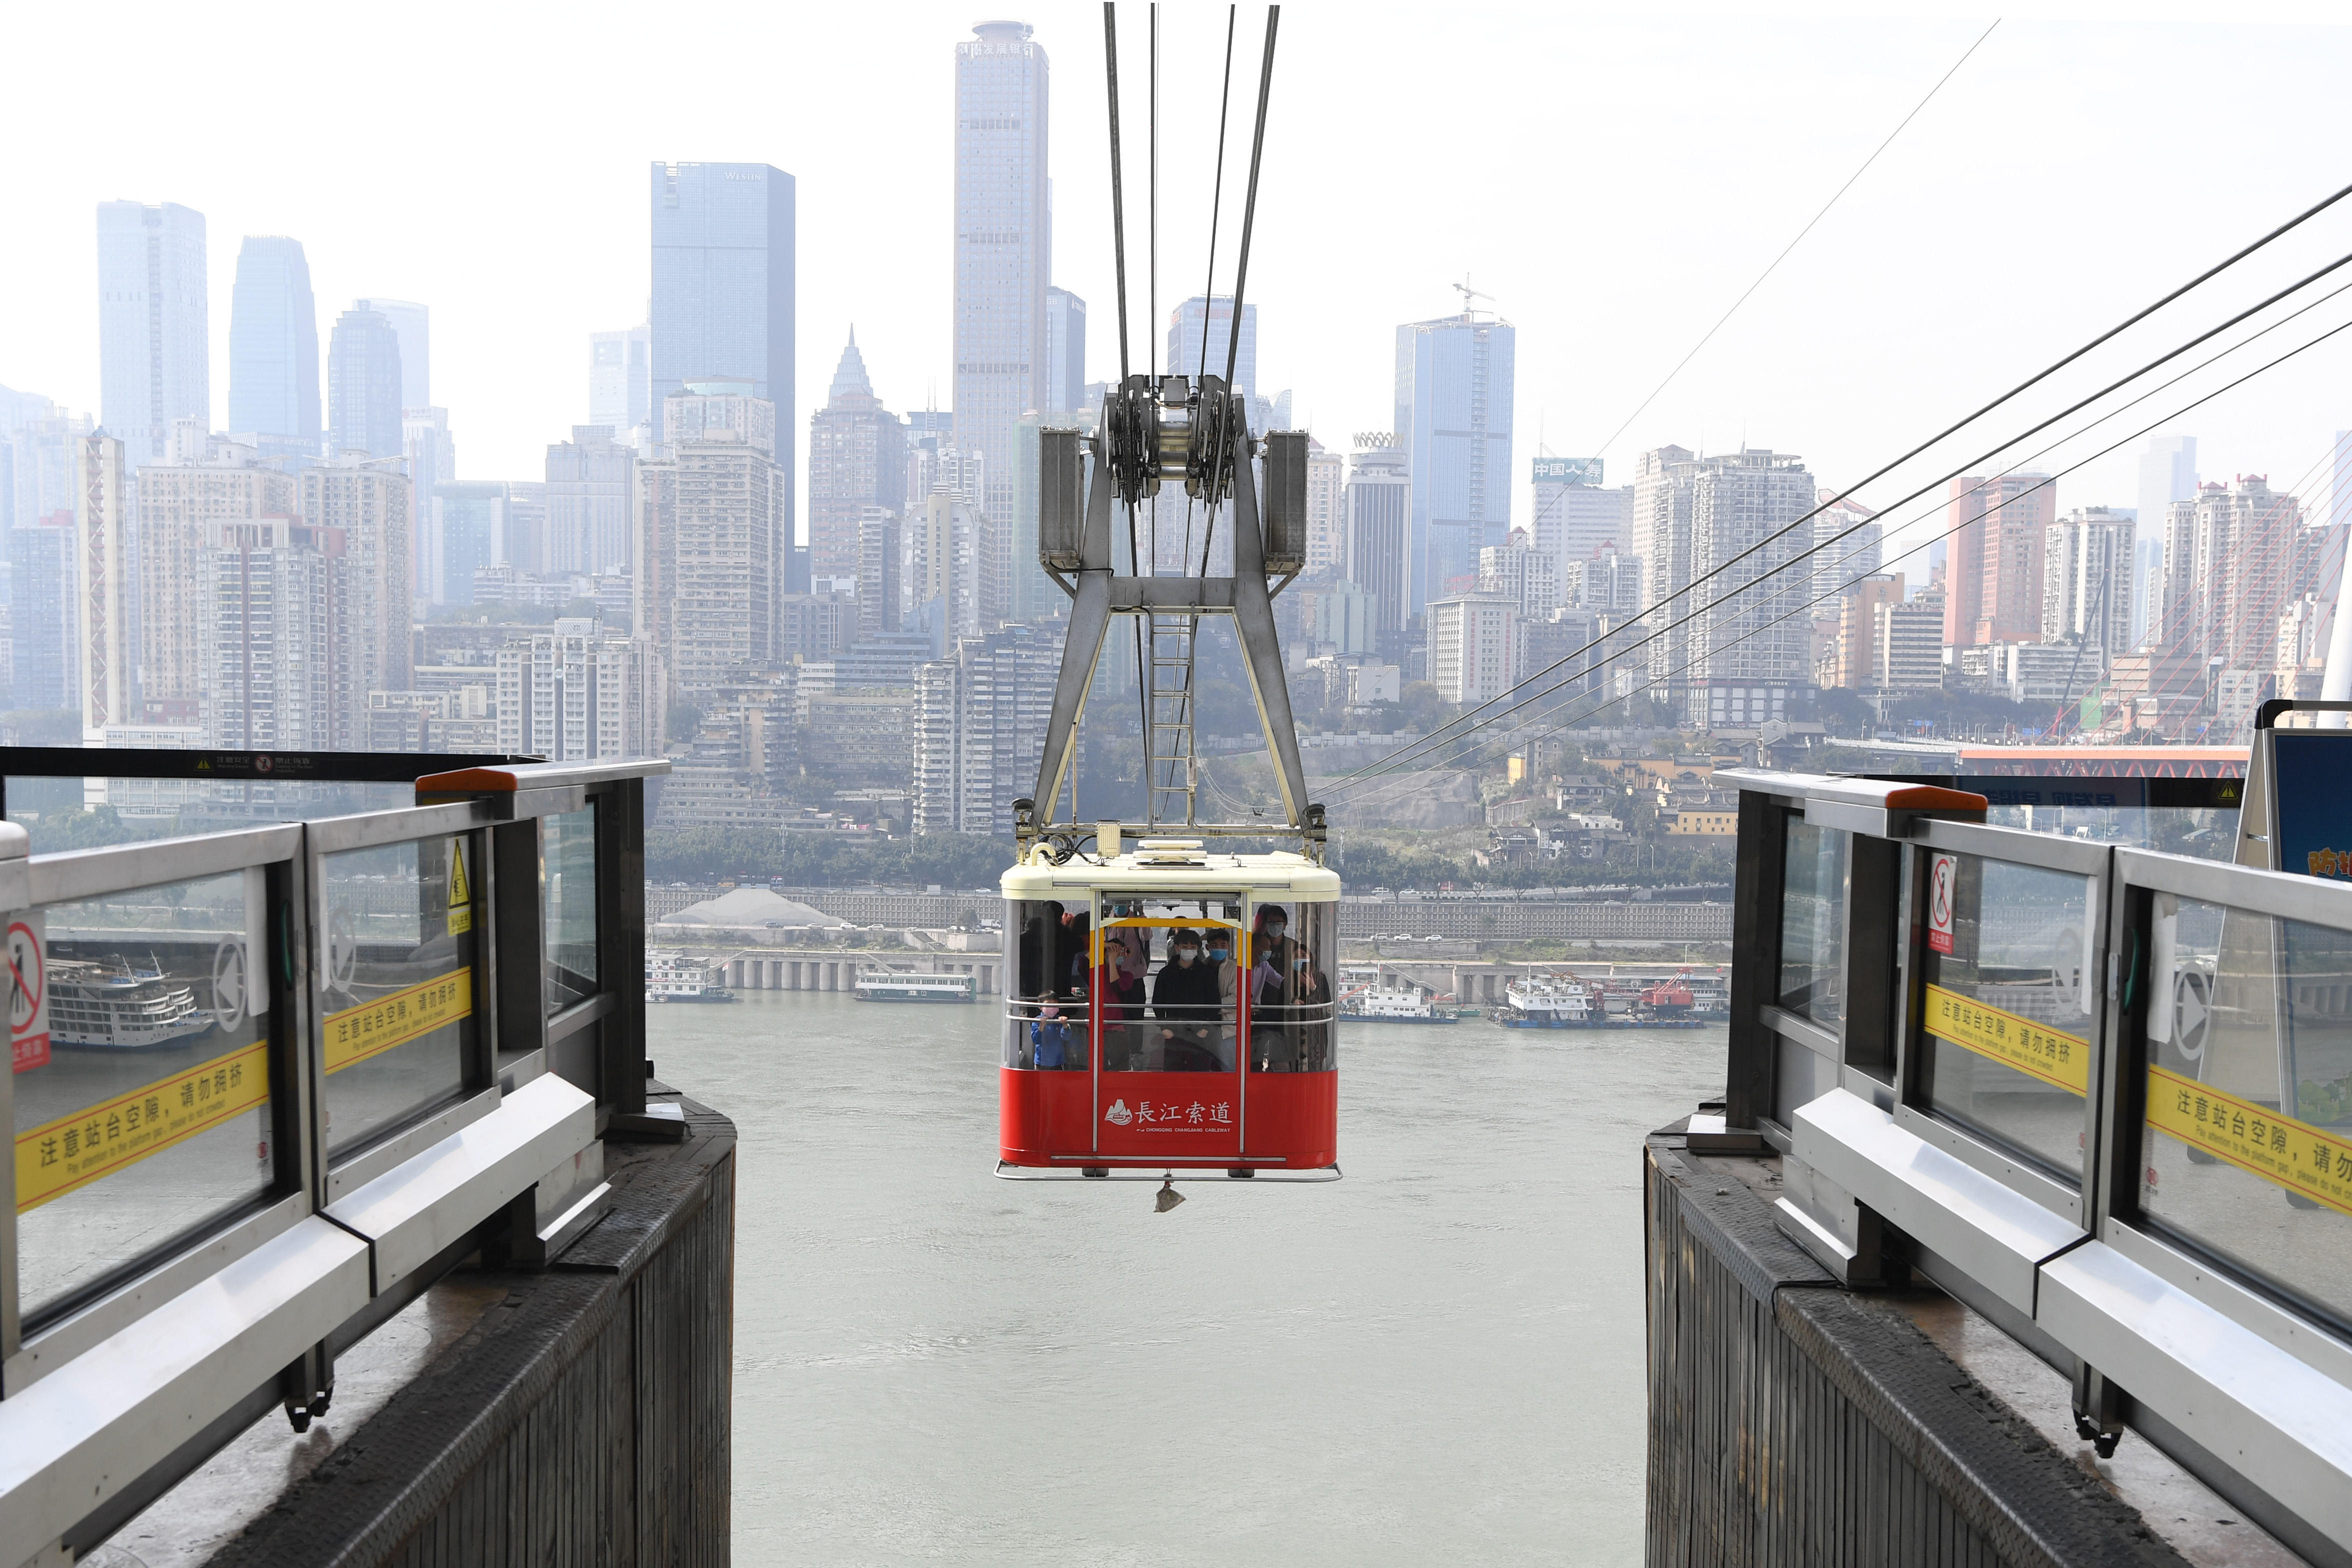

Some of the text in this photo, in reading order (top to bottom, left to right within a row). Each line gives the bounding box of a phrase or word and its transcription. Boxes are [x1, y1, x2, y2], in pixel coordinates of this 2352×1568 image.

[724, 172, 760, 180] WESTIN
[1534, 461, 1602, 477] 中国人寿
[338, 982, 456, 1043] 注意站台空隙，请勿拥挤
[1942, 999, 2070, 1065] 注意站台空隙，请勿拥挤
[40, 1062, 242, 1168] 注意站台空隙，请勿拥挤
[1134, 1101, 1233, 1125] 長江索道
[2196, 1125, 2206, 1140] Pay
[2208, 1132, 2231, 1148] attention
[2233, 1142, 2238, 1152] to
[2240, 1145, 2250, 1158] the
[2251, 1150, 2276, 1167] platform
[2298, 1170, 2318, 1186] please
[2320, 1180, 2329, 1190] do
[2332, 1185, 2342, 1196] not
